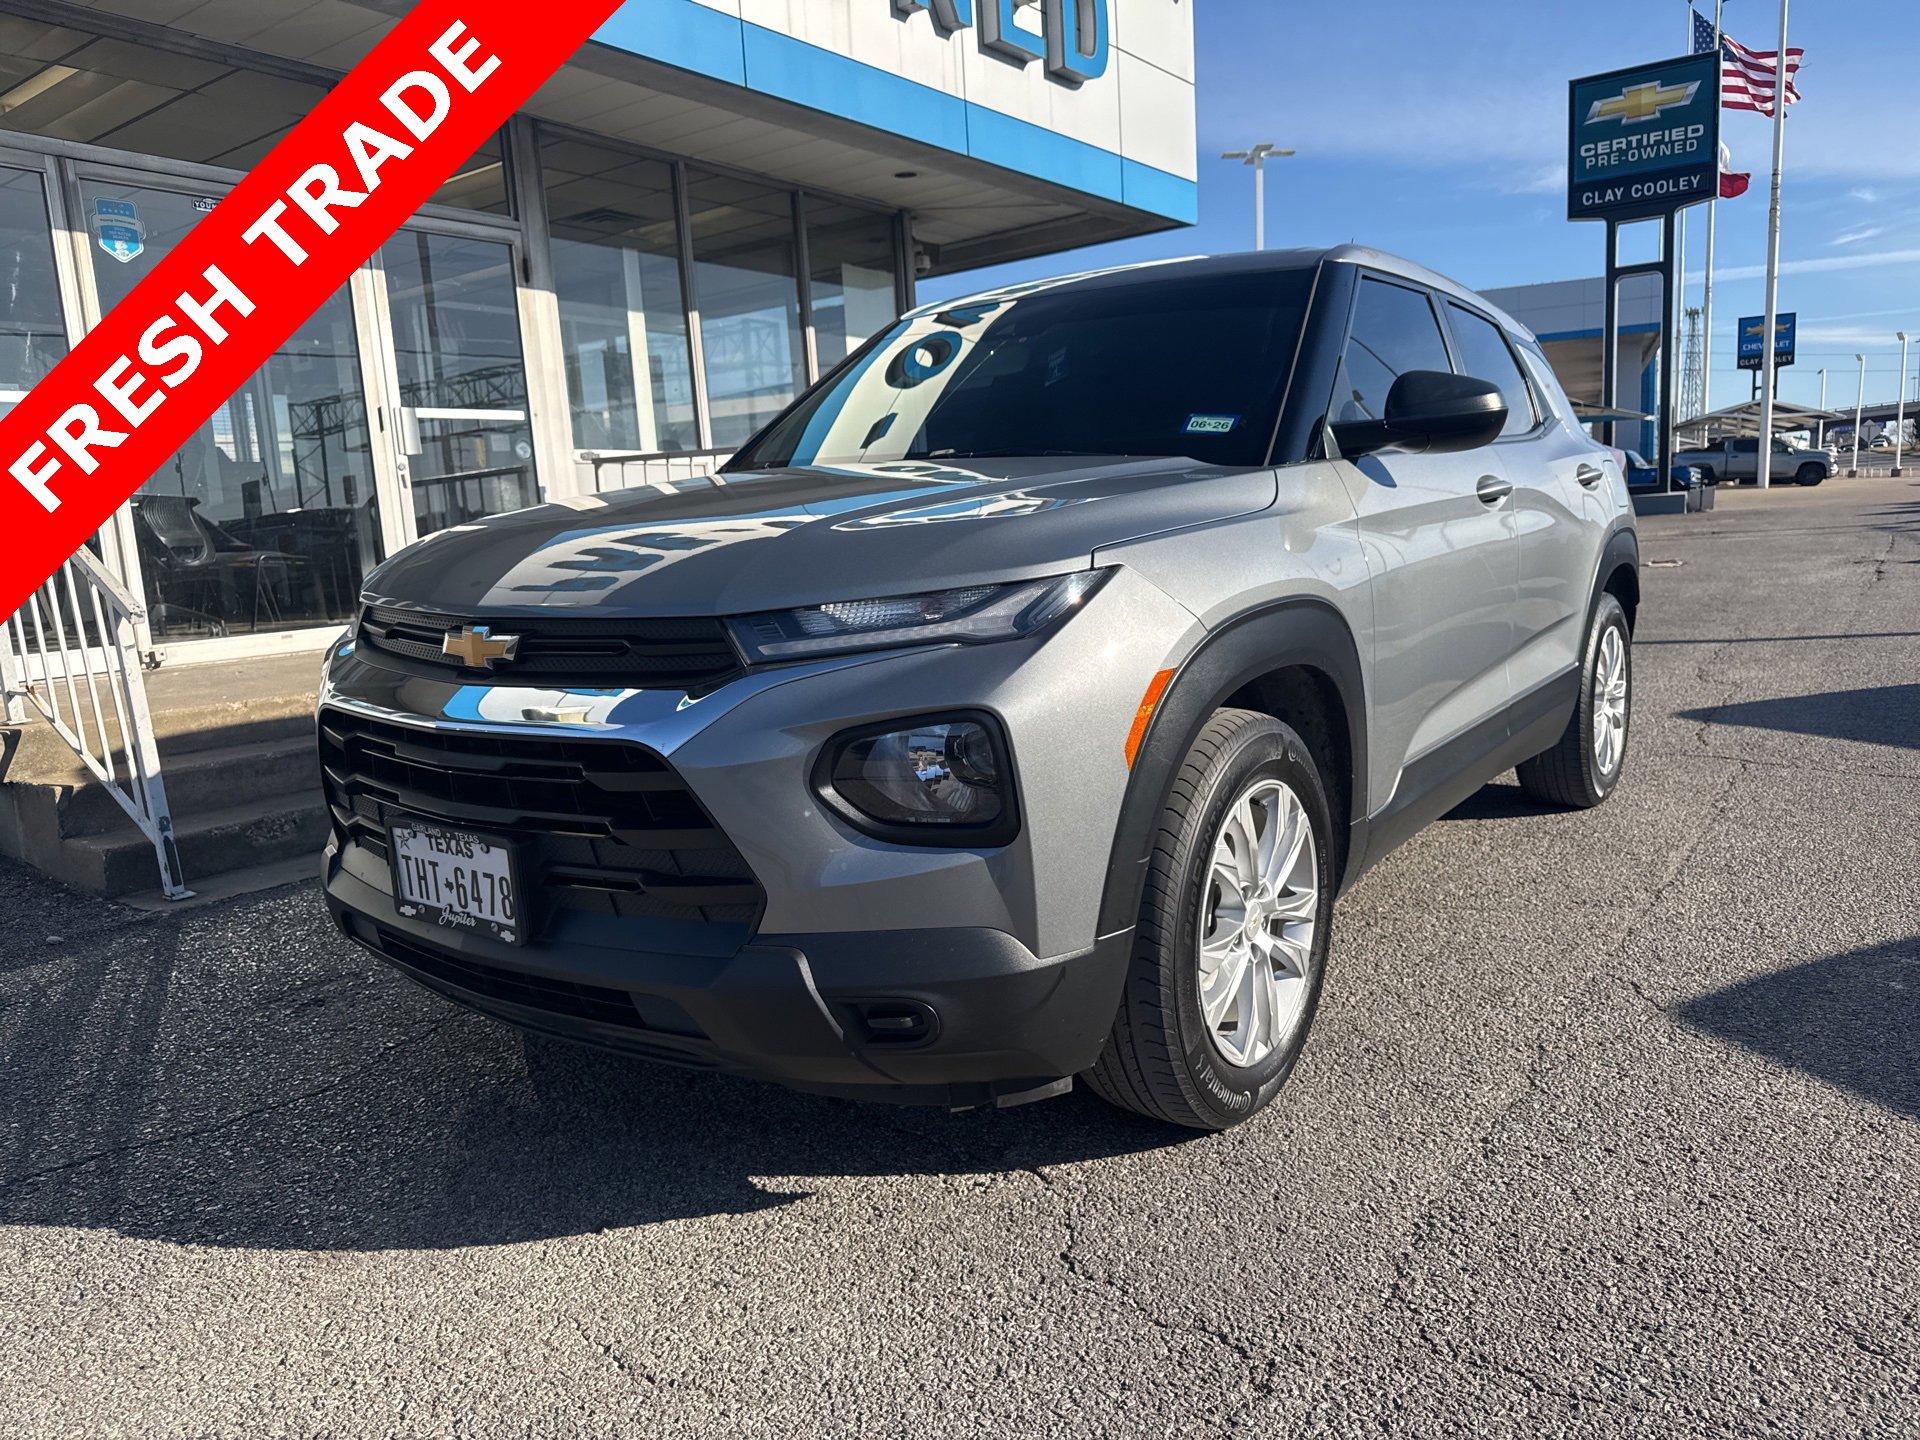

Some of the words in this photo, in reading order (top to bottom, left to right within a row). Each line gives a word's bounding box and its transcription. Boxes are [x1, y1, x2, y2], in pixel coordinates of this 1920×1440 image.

[1580, 123, 1705, 158] CERTIFIED
[1585, 139, 1698, 170] PRE-OWNED
[1582, 186, 1625, 206] CLAY
[1631, 174, 1702, 199] COOLEY
[1742, 339, 1790, 351] CHEVLET
[411, 823, 441, 837] GARLAND
[454, 832, 480, 844] TEXAS
[425, 834, 474, 860] TEXAS
[1199, 1064, 1252, 1114] Continental
